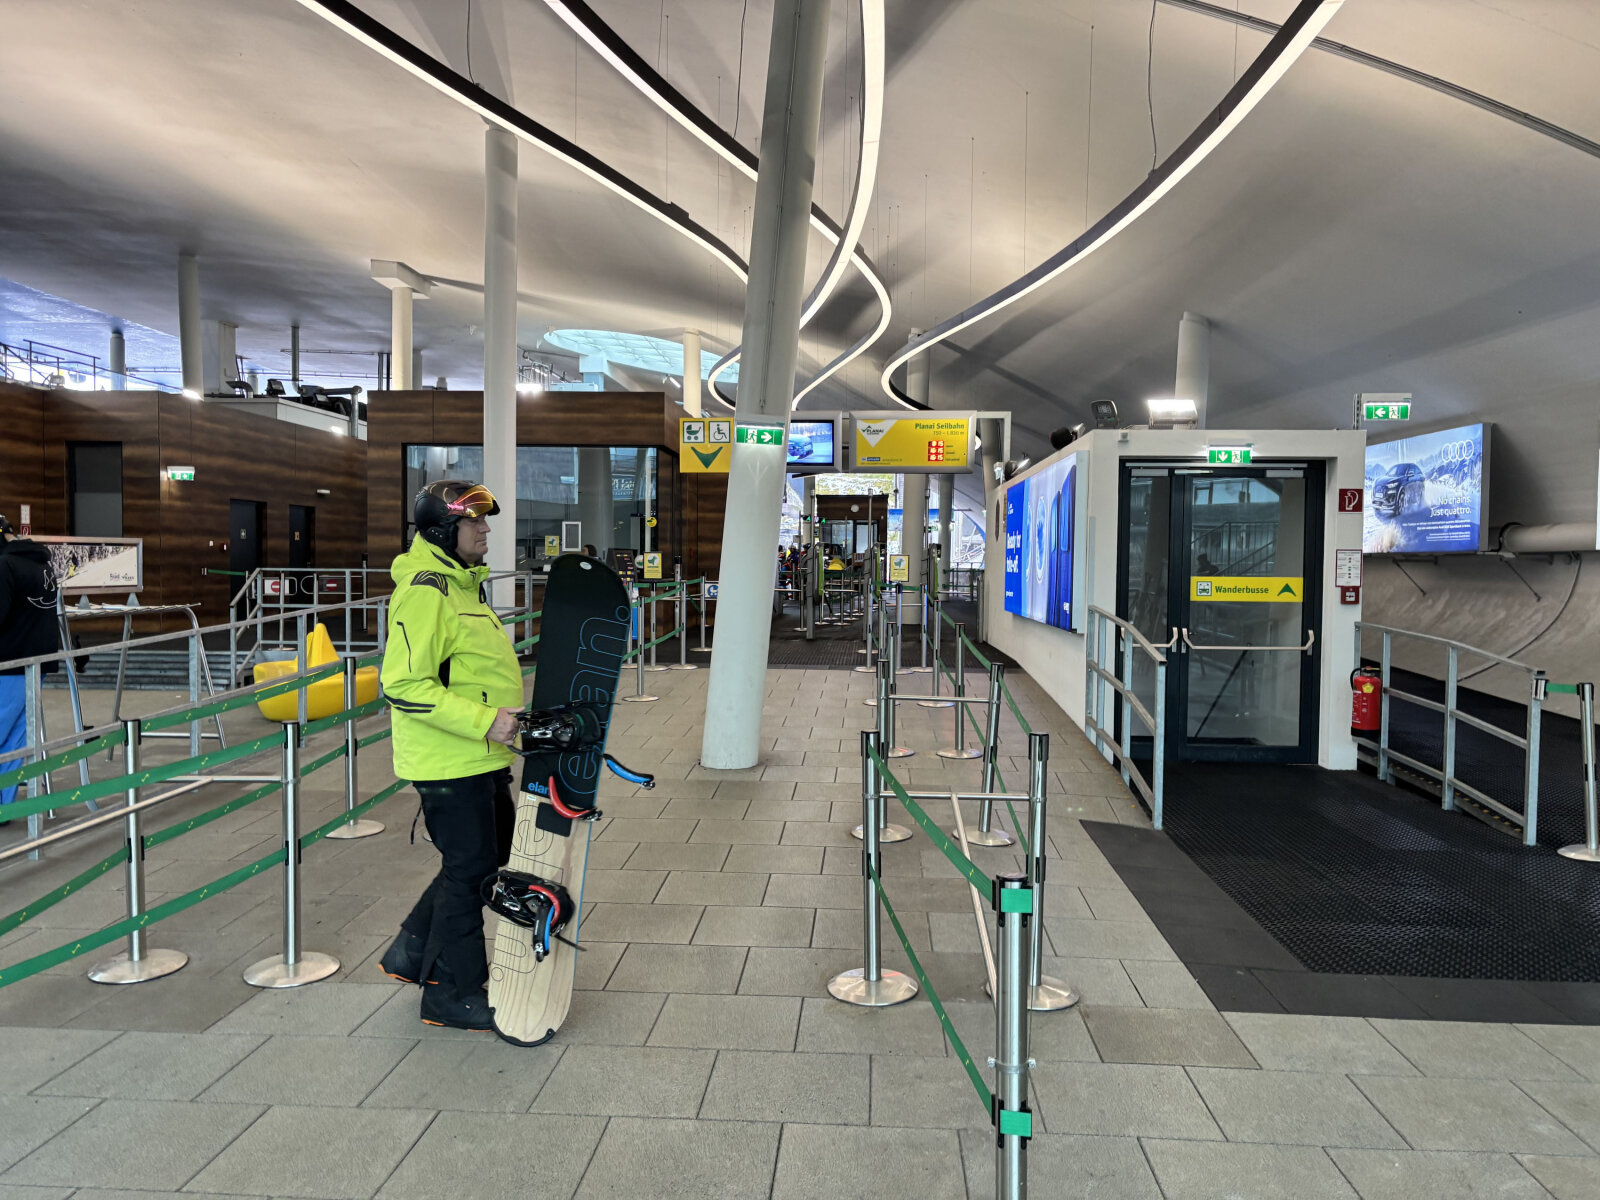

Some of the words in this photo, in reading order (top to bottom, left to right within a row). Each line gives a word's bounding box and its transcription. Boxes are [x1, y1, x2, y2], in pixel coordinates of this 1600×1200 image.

[915, 422, 935, 430] Planai
[936, 422, 965, 430] Seilbahn
[1438, 497, 1448, 505] No
[1449, 495, 1472, 505] chains.
[1430, 506, 1443, 518] Just
[1444, 506, 1472, 517] quattro.
[1215, 585, 1270, 594] Wanderbusse
